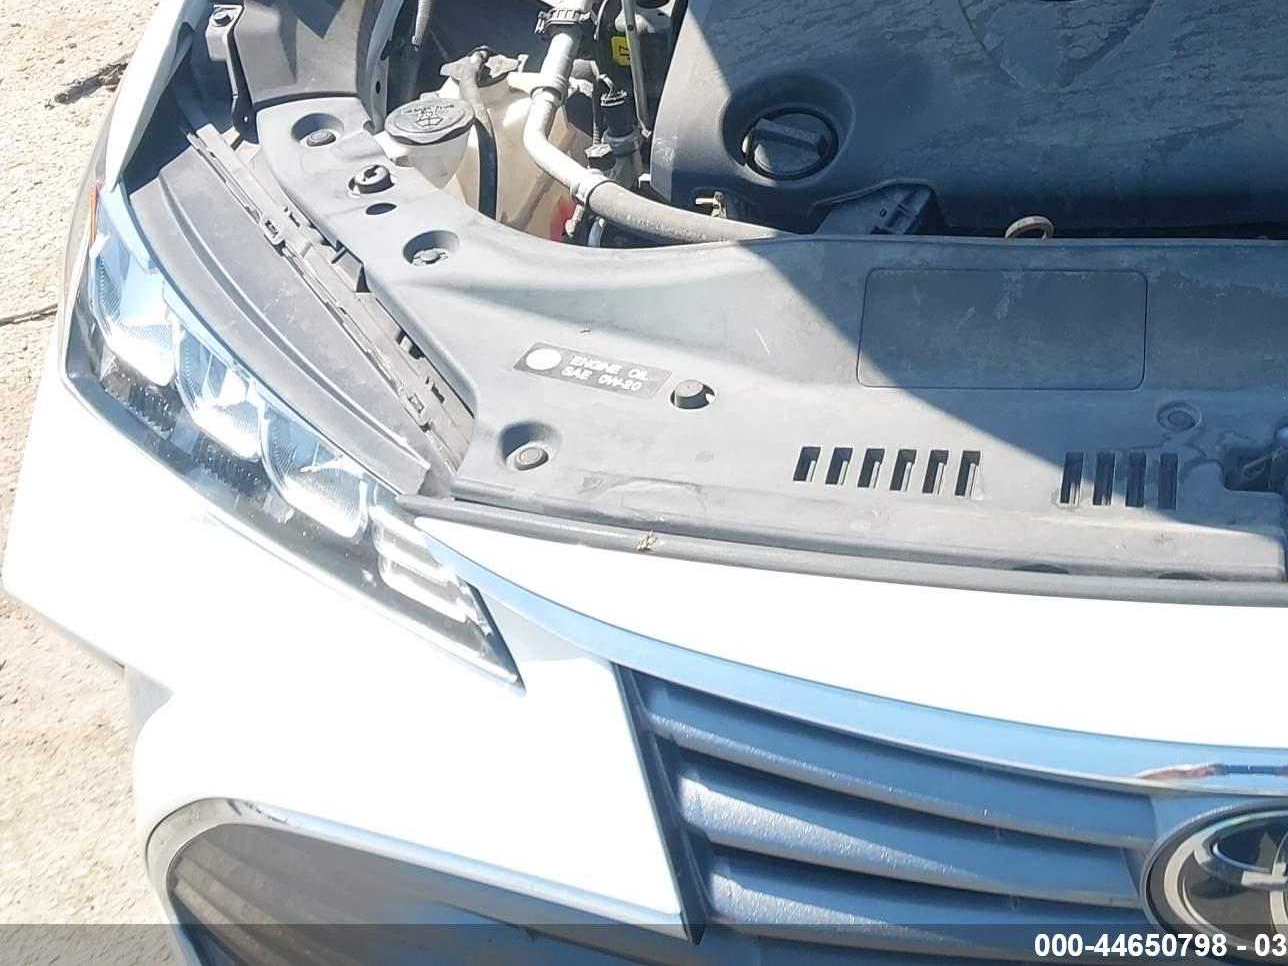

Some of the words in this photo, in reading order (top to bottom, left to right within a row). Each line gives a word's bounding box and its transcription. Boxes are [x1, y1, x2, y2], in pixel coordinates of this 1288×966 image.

[561, 366, 593, 381] SAE
[598, 374, 642, 392] 0W-20
[570, 355, 623, 375] ENGINE
[628, 368, 649, 382] OIL
